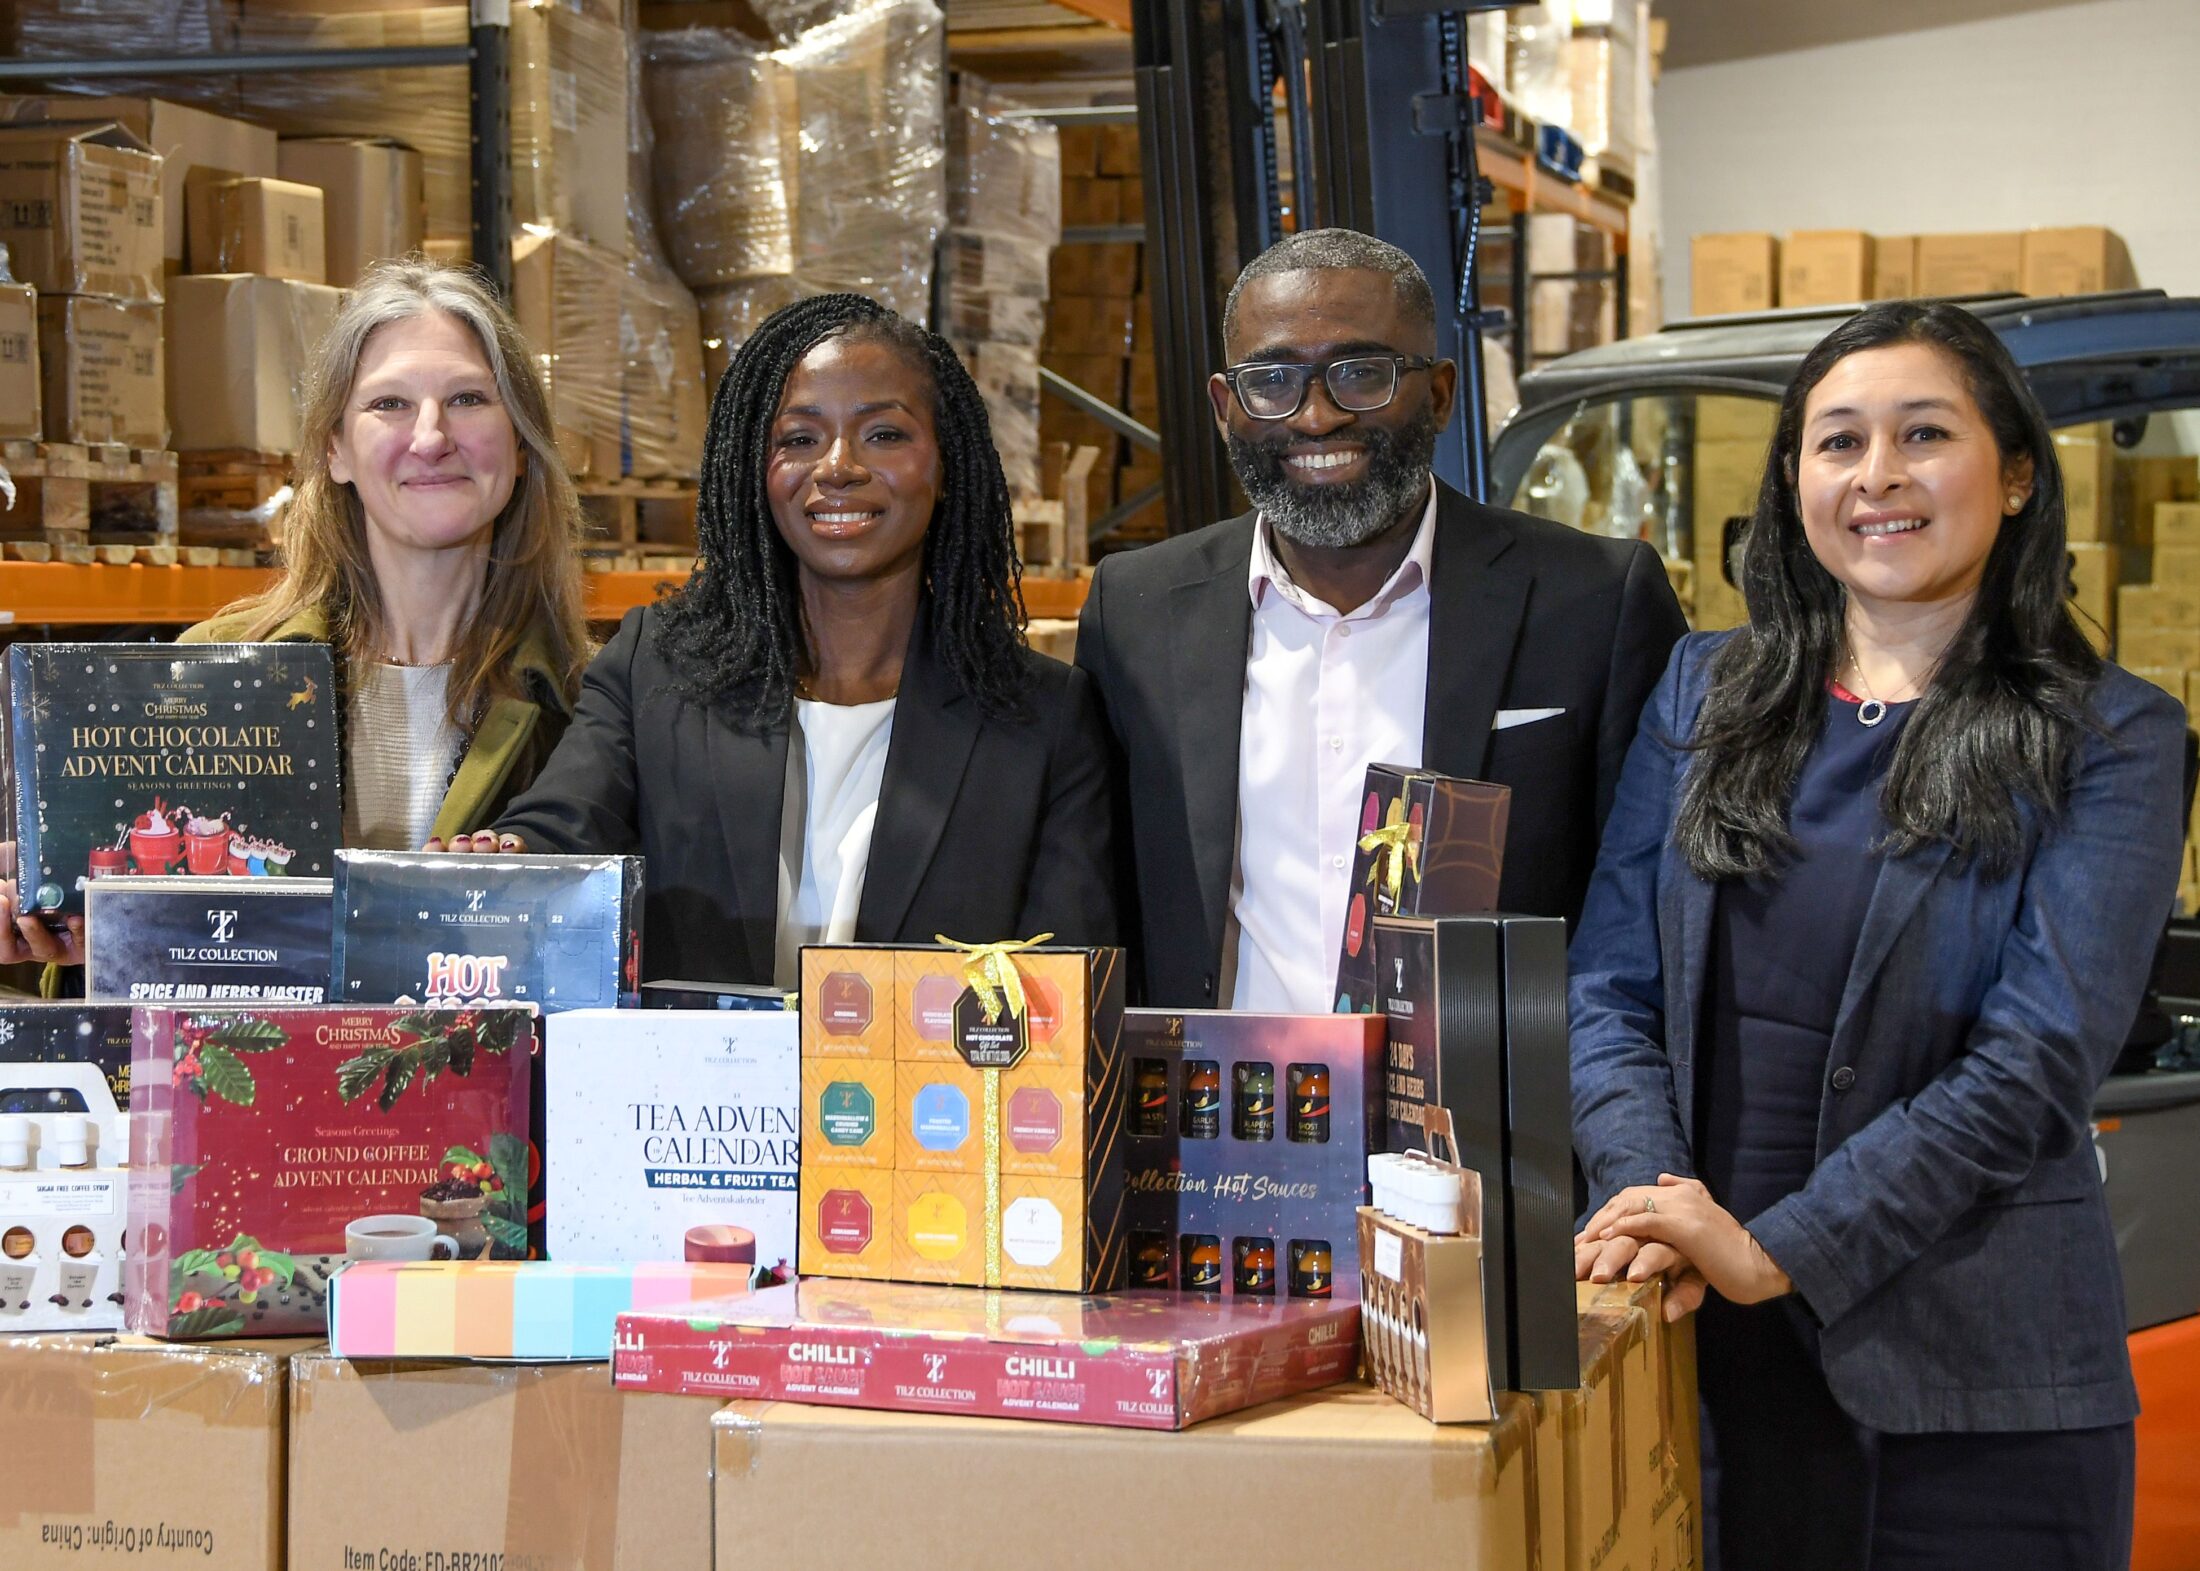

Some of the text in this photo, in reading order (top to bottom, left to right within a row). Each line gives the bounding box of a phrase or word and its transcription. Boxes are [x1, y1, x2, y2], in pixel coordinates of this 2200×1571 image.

[145, 702, 208, 717] CHRISTMAS
[72, 726, 281, 748] HOT CHOCOLATE
[61, 754, 294, 777] ADVENT CALENDAR
[128, 782, 231, 790] SEASONS GREETINGS
[440, 914, 510, 924] TILZ COLLECTION
[552, 916, 563, 924] 22
[168, 948, 278, 962] TILZ COLLECTION
[425, 952, 508, 998] HOT
[130, 982, 175, 1000] SPICE
[175, 984, 207, 999] AND
[261, 986, 324, 1003] MASTER
[342, 1017, 373, 1026] MERRY
[316, 1025, 400, 1045] CHRISTMAS
[979, 1034, 1014, 1042] CHOCOLATE
[628, 1104, 798, 1134] TEA ADVEN
[315, 1125, 400, 1138] Seasons Greetings
[284, 1144, 430, 1164] GROUND COFFEE
[644, 1136, 800, 1166] CALENDAR
[273, 1168, 439, 1188] ADVENT CALENDAR
[654, 1172, 796, 1188] HERBAL & FRUIT TEA
[1214, 1172, 1251, 1199] Hot
[1252, 1175, 1318, 1200] Sauces
[1308, 1322, 1338, 1345] CHILLI
[788, 1342, 856, 1364] CHILLI
[682, 1371, 760, 1386] TILZ COLLECTION
[780, 1363, 865, 1387] HOT SAUCE
[1004, 1358, 1076, 1379] CHILLI
[786, 1384, 860, 1396] ADVENT CALENDAR
[894, 1385, 976, 1400] TILZ COLLECTION
[996, 1378, 1086, 1403] HOT SAUCE
[1002, 1398, 1080, 1411] ADVENT CALENDAR
[1116, 1400, 1137, 1412] TILZ
[42, 1520, 213, 1555] Country of Origin: China
[344, 1545, 375, 1570] Item
[380, 1548, 421, 1571] Code:
